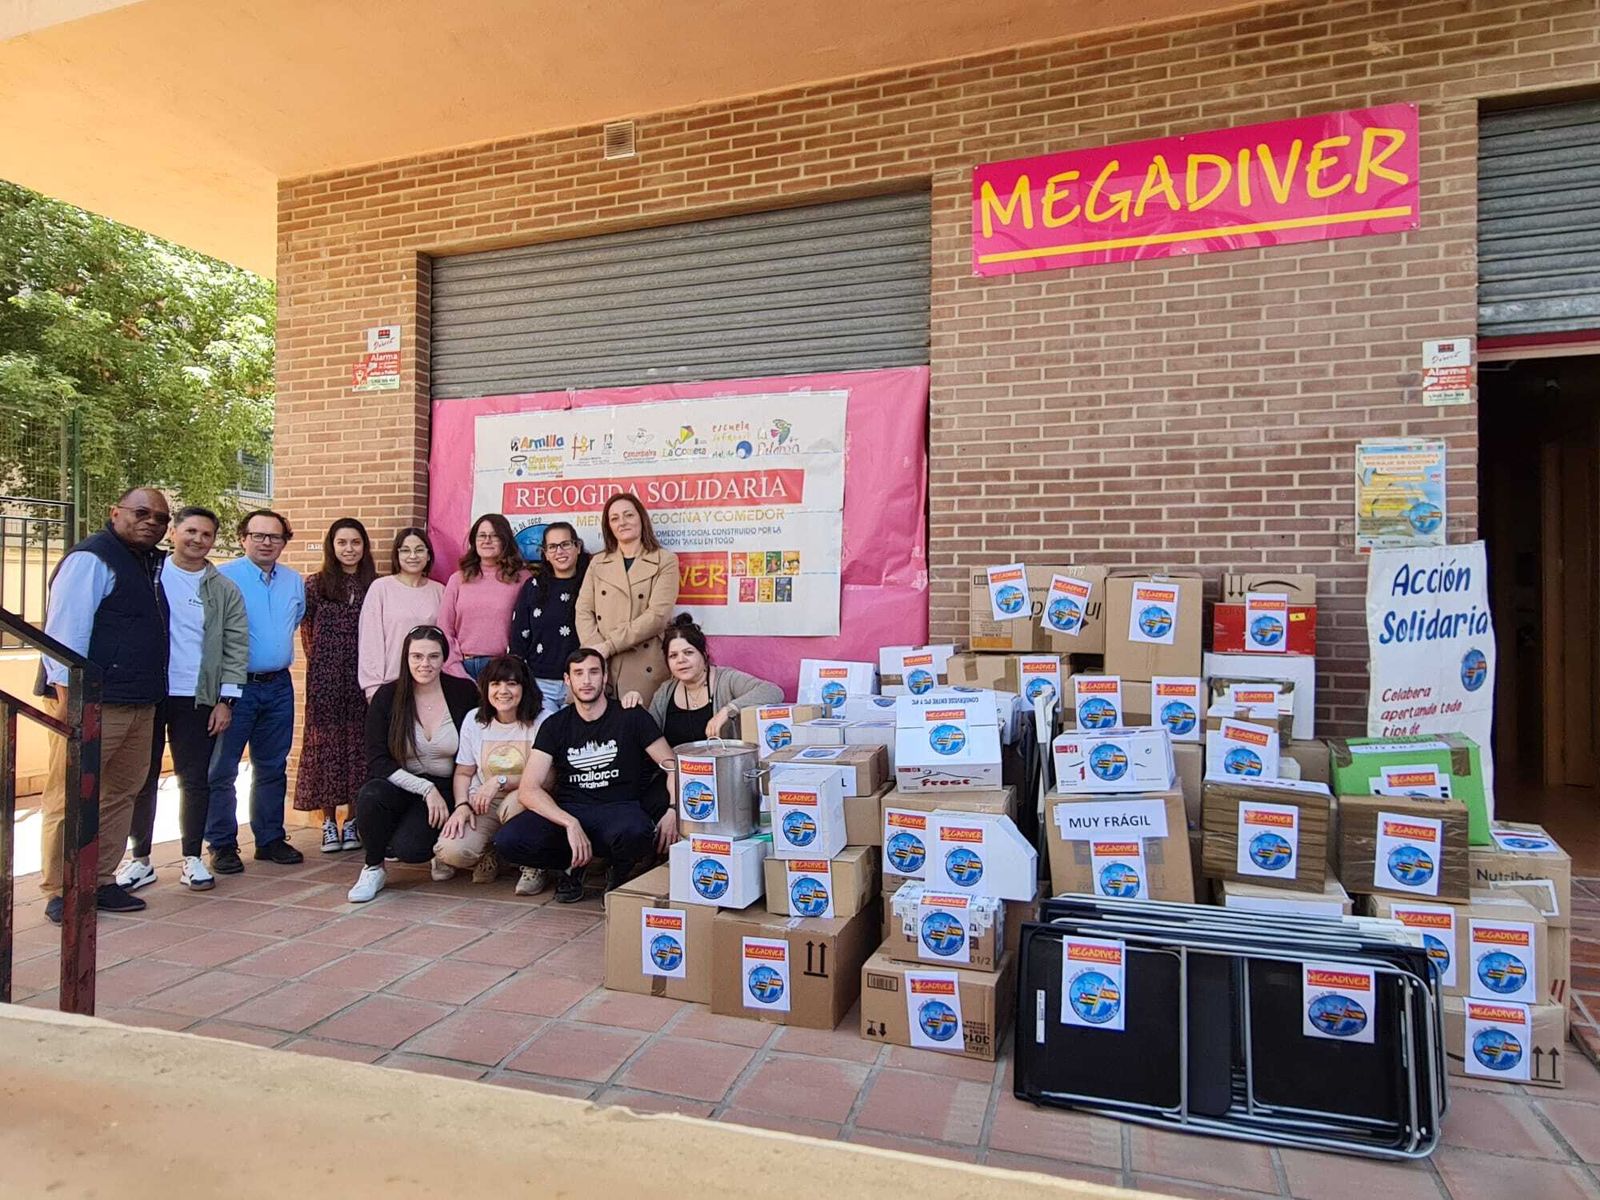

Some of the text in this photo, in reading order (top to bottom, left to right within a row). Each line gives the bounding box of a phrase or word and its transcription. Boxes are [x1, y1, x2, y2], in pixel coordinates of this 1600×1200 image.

[979, 127, 1409, 238] MEGADIVER
[520, 433, 565, 449] Armilla
[647, 475, 788, 503] SOLIDARIA
[650, 510, 701, 525] COCINA
[703, 511, 713, 522] Y
[713, 508, 785, 522] COMEDOR
[1391, 559, 1471, 596] Acción
[1379, 605, 1488, 644] Solidaria
[1382, 686, 1431, 703] Colabora
[1381, 699, 1462, 721] aportando todo
[1409, 723, 1420, 735] de
[569, 769, 619, 783] mallorca
[1069, 813, 1151, 828] MUY FRÁGIL
[1473, 930, 1528, 943] MEGADIVER
[743, 946, 784, 958] MEGADIVER
[1068, 947, 1121, 961] MEGADIVER
[1308, 974, 1369, 988] MEGADIVER
[1470, 1008, 1525, 1021] MEGADIVER
